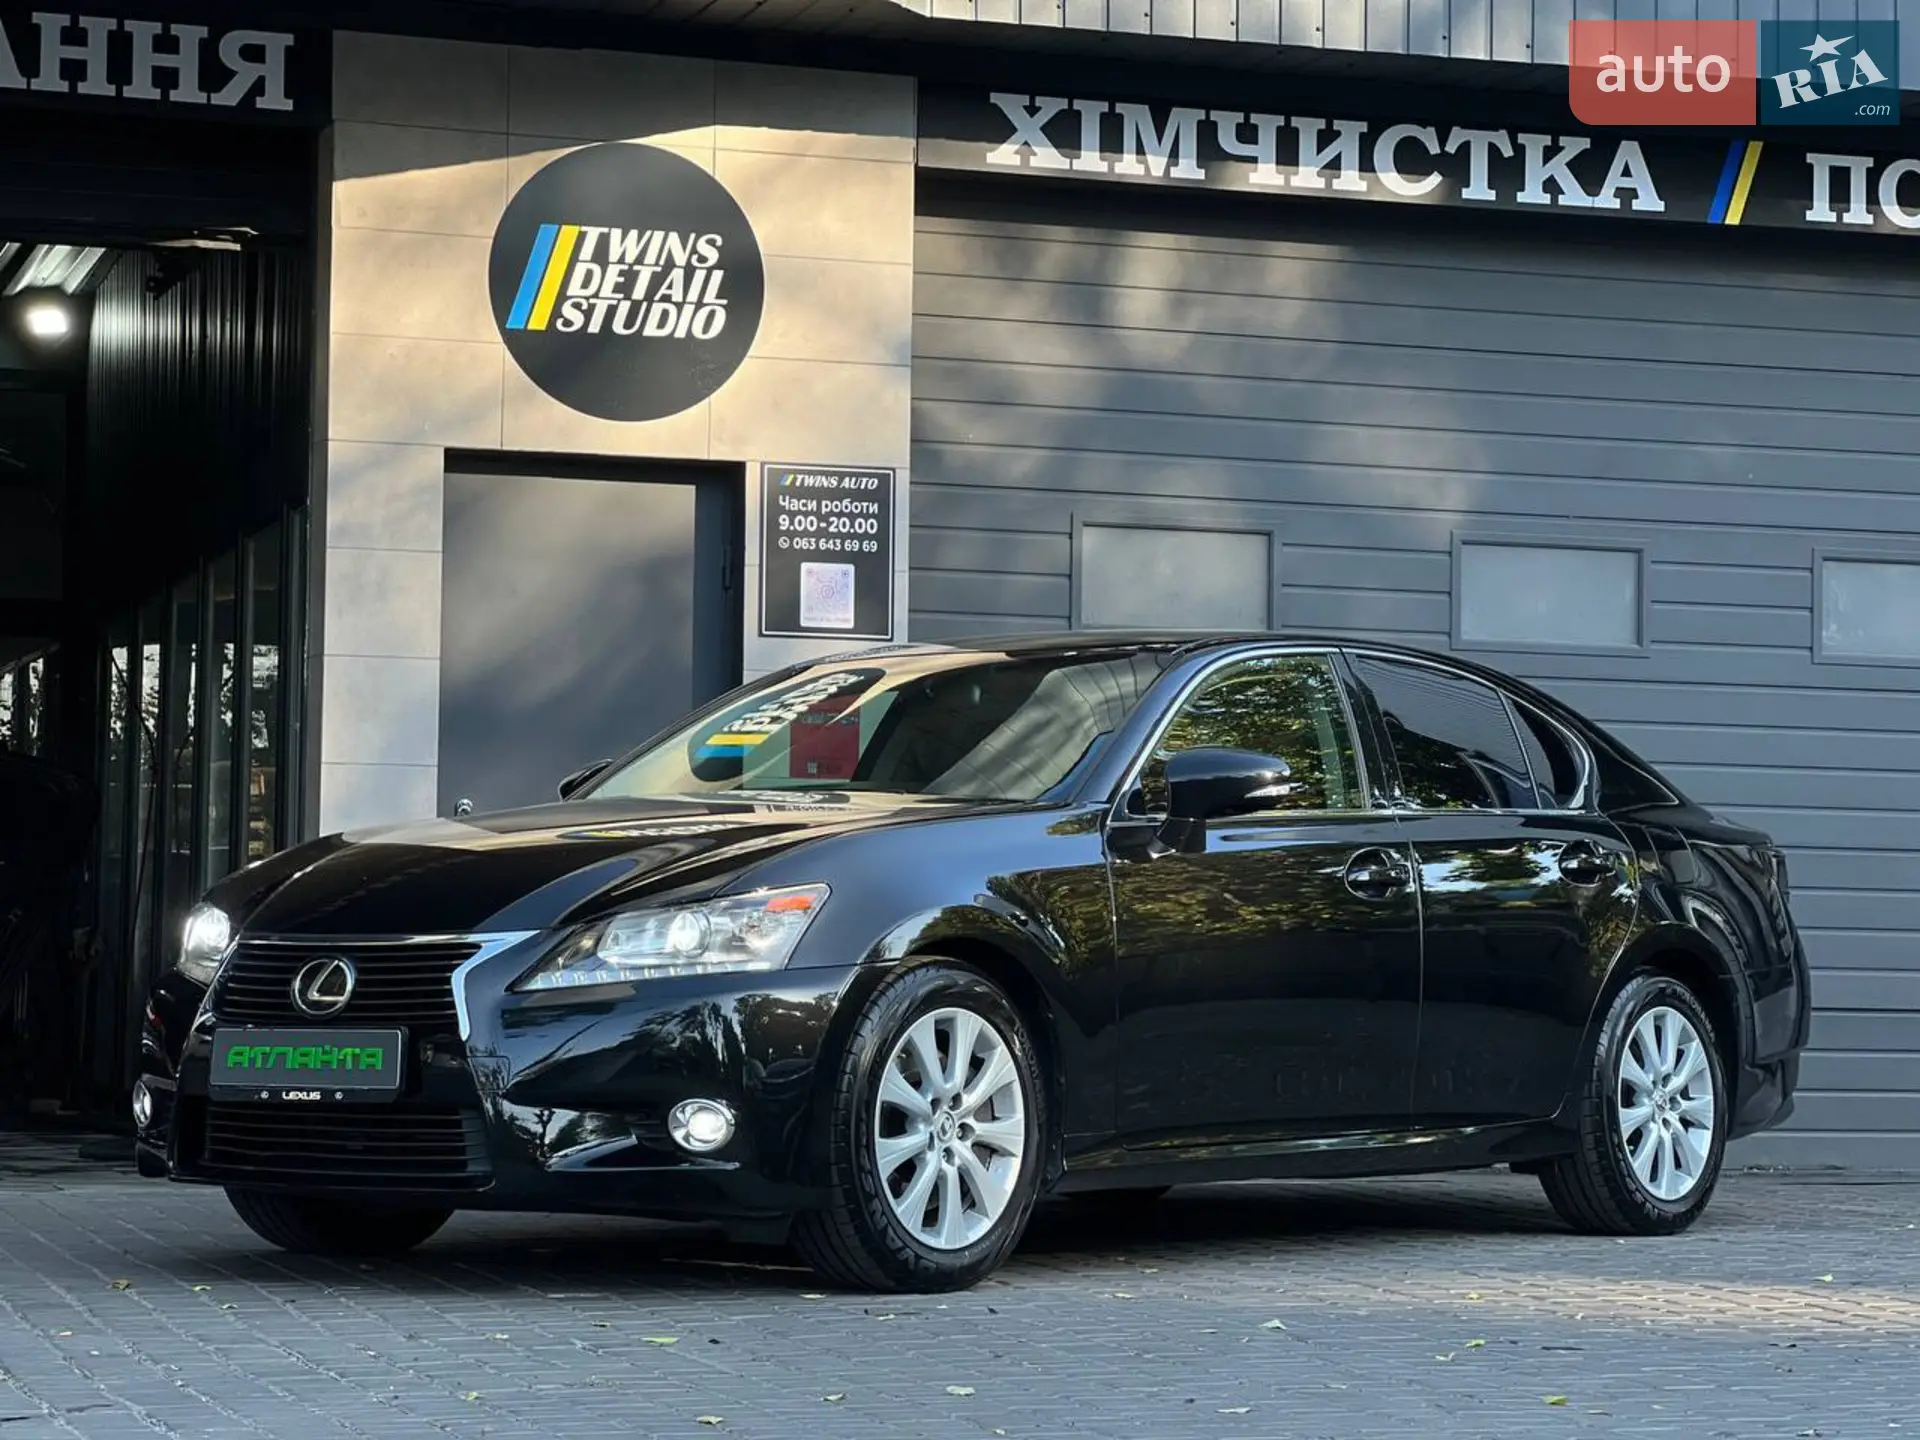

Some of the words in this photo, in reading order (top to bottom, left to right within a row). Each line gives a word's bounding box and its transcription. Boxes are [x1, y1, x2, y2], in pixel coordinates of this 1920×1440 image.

[986, 92, 1666, 213] ХІМЧИСТКА
[578, 225, 724, 268] TWINS
[566, 261, 729, 305] DETAIL
[555, 297, 728, 340] STUDIO
[795, 474, 839, 489] TWINS
[840, 476, 879, 490] AUTO
[779, 494, 817, 512] Часи
[821, 498, 879, 515] роботи
[793, 536, 817, 550] 063
[819, 538, 842, 551] 643
[844, 539, 860, 552] 69
[862, 540, 878, 553] 69
[281, 1091, 322, 1101] LEXUS
